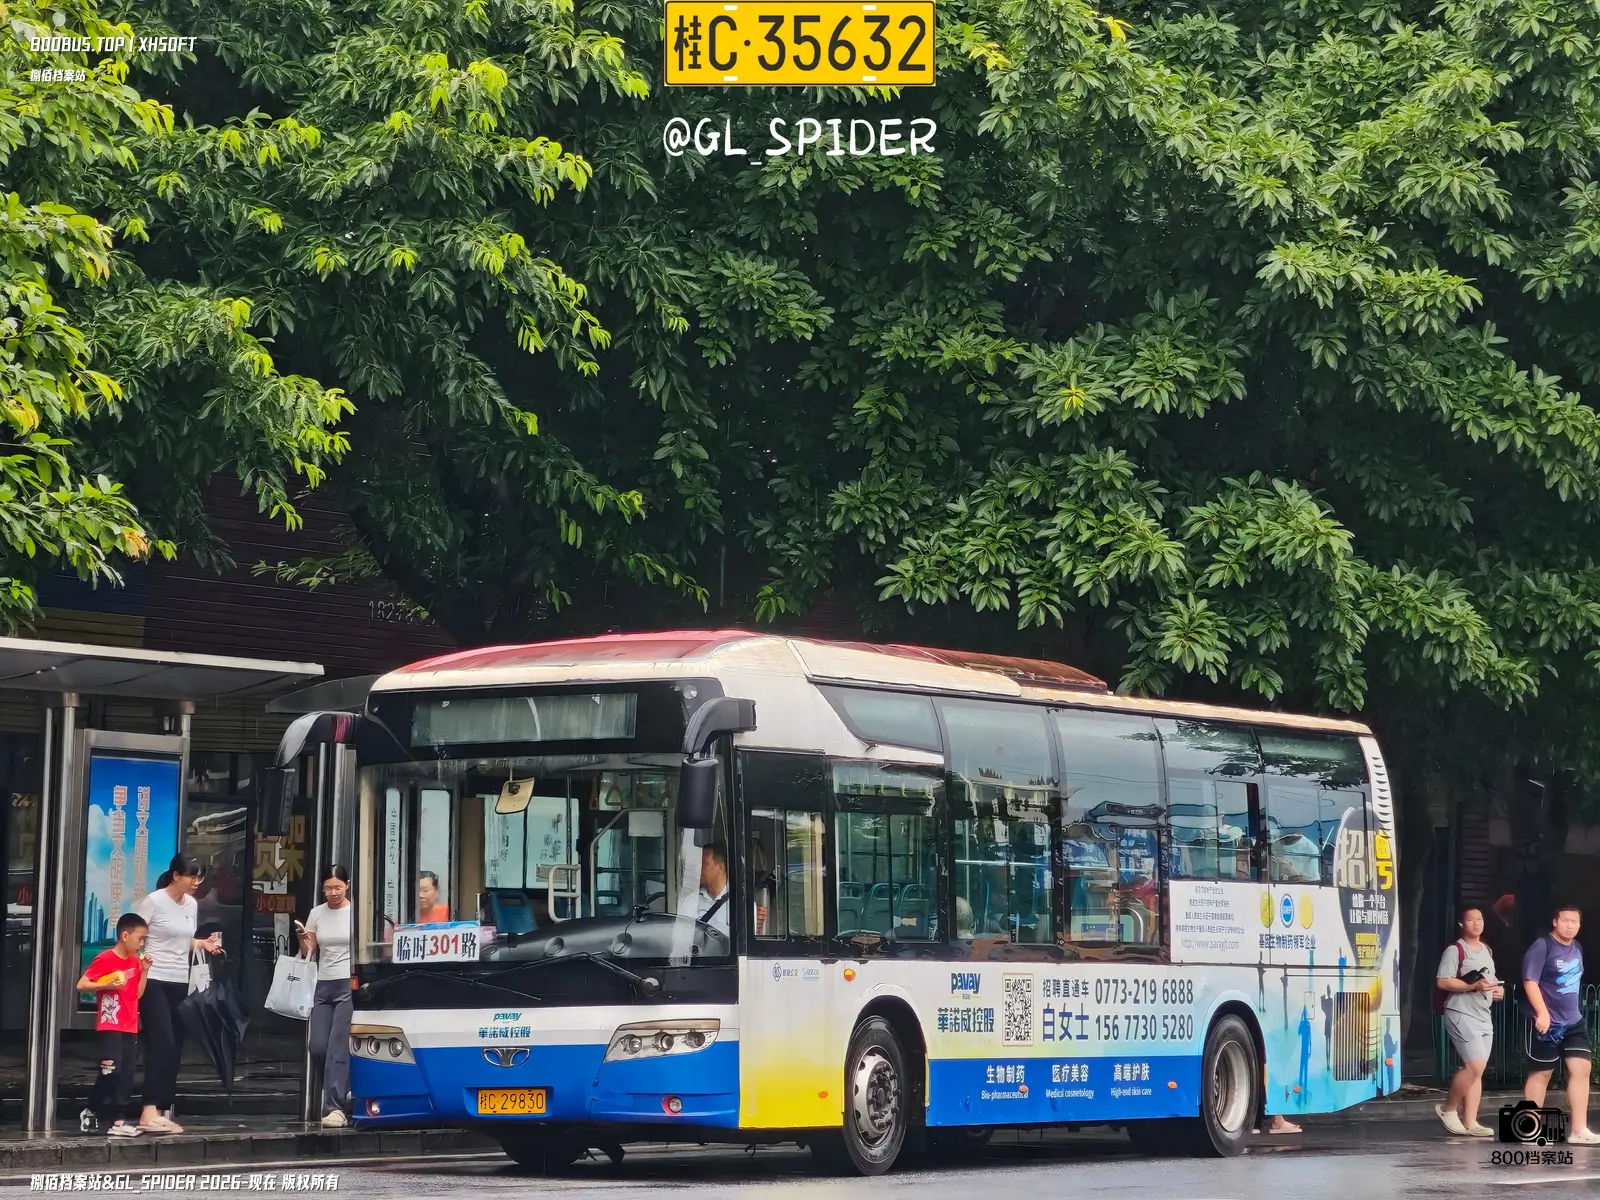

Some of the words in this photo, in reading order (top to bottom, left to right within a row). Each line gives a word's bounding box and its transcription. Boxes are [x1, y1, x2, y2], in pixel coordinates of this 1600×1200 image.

[397, 932, 476, 961] 临时301路
[1259, 933, 1316, 950] 基因生物制药领军企业
[950, 972, 981, 994] pavay
[1042, 979, 1089, 998] 招聘直通车
[1095, 978, 1157, 1004] 0773-219
[1162, 978, 1194, 1004] 6888
[493, 1012, 522, 1021] pavay
[937, 1007, 995, 1033] 華諾威控股
[1042, 1003, 1089, 1042] 白女士
[1095, 1014, 1120, 1040] 156
[1124, 1014, 1157, 1040] 7730
[1162, 1014, 1194, 1040] 5280
[478, 1026, 531, 1039] 華諾威控股
[986, 1064, 1025, 1084] 生物制药
[1052, 1064, 1089, 1083] 医疗美容
[1113, 1063, 1150, 1081] 高端护肤
[1045, 1088, 1064, 1098] Medical
[1064, 1088, 1095, 1100] cosmetology
[1110, 1087, 1131, 1099] High-end
[1131, 1087, 1141, 1096] skin
[1141, 1087, 1152, 1096] care
